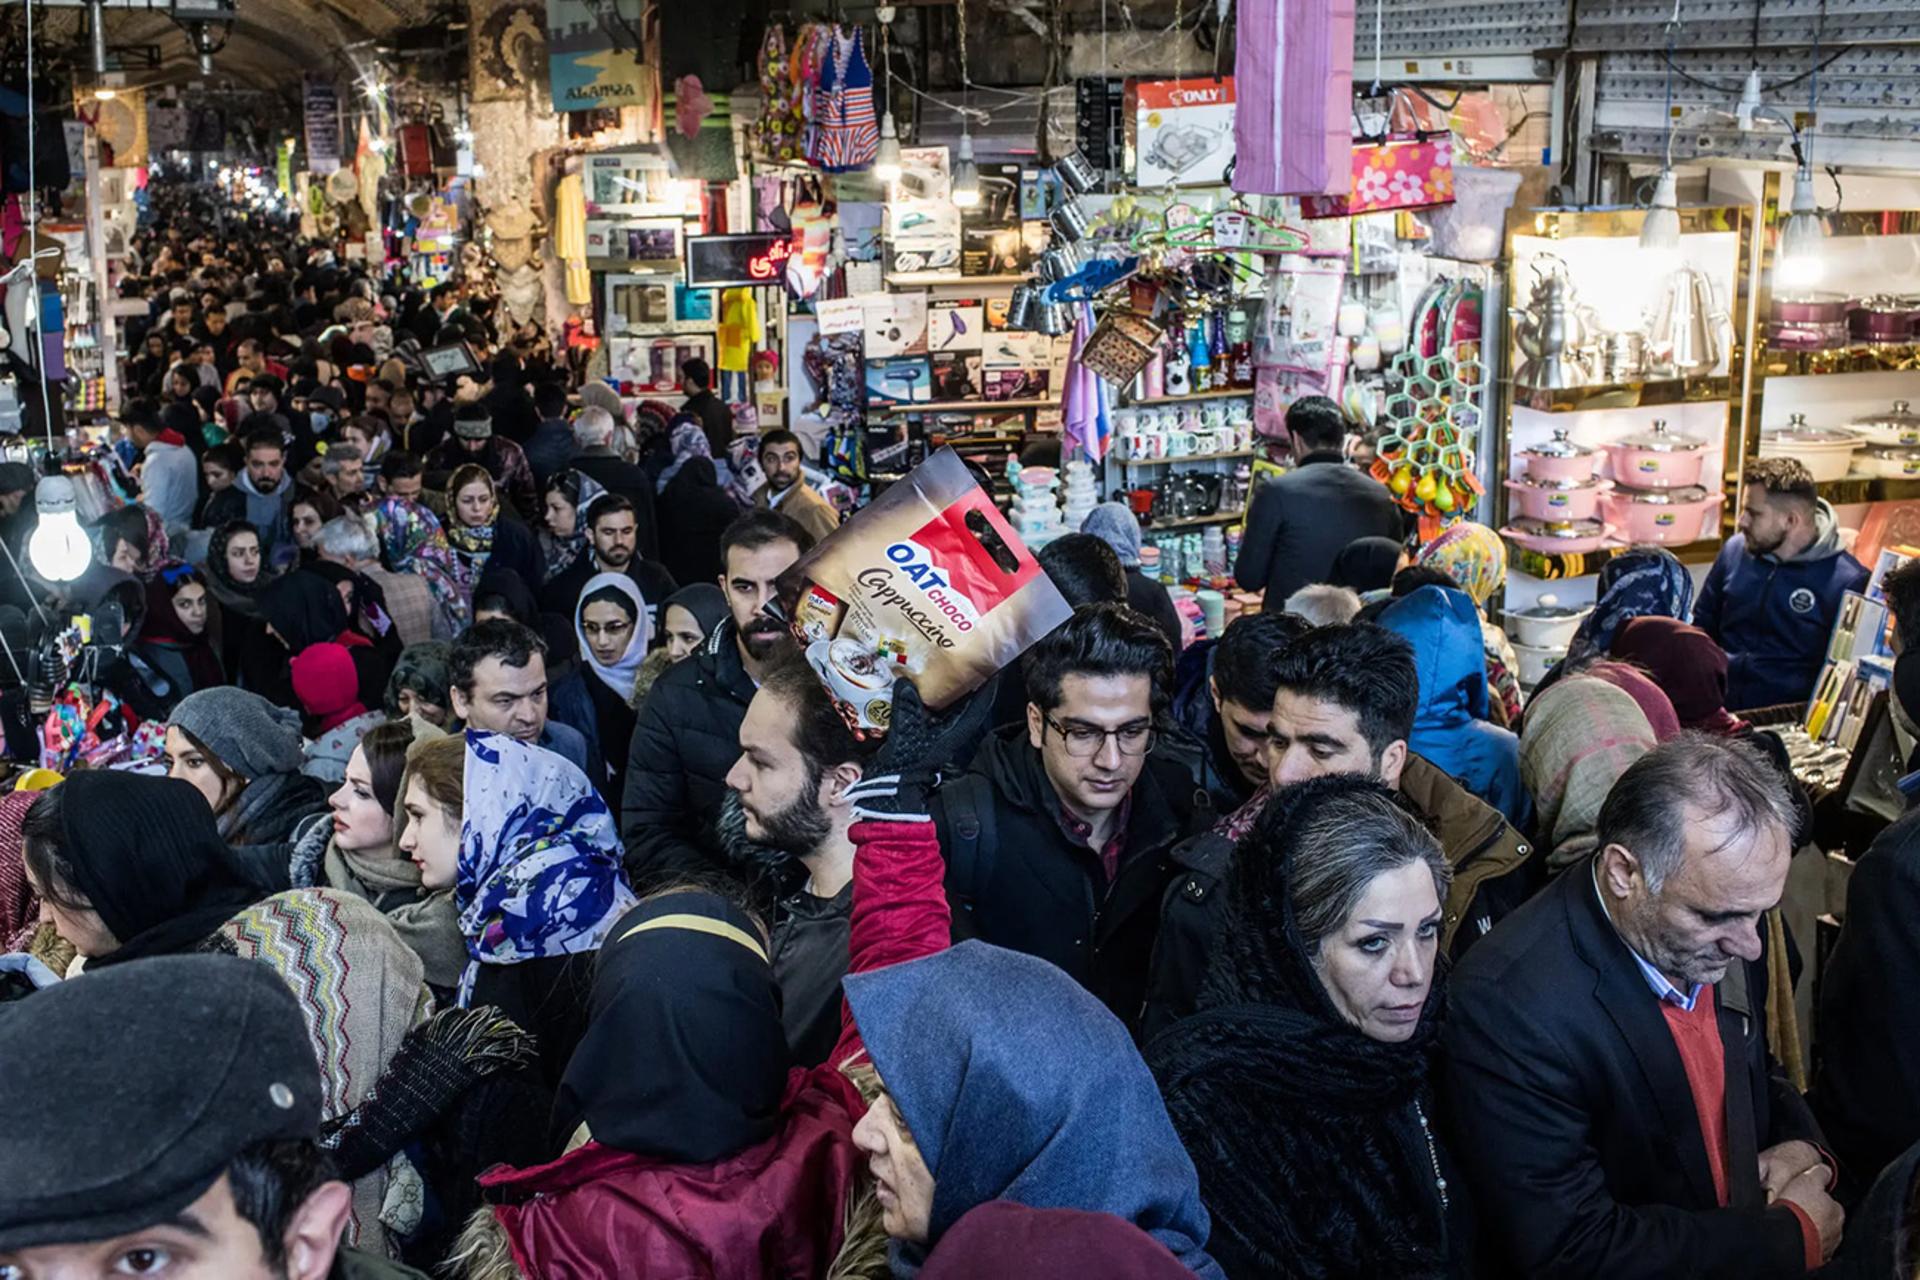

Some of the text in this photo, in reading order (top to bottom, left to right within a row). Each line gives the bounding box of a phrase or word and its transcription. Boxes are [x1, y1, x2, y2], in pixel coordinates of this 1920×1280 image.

[1184, 88, 1219, 102] ONLY
[857, 567, 956, 649] Cappuccino
[886, 543, 974, 632] OAT CHOCO
[873, 700, 892, 719] 20
